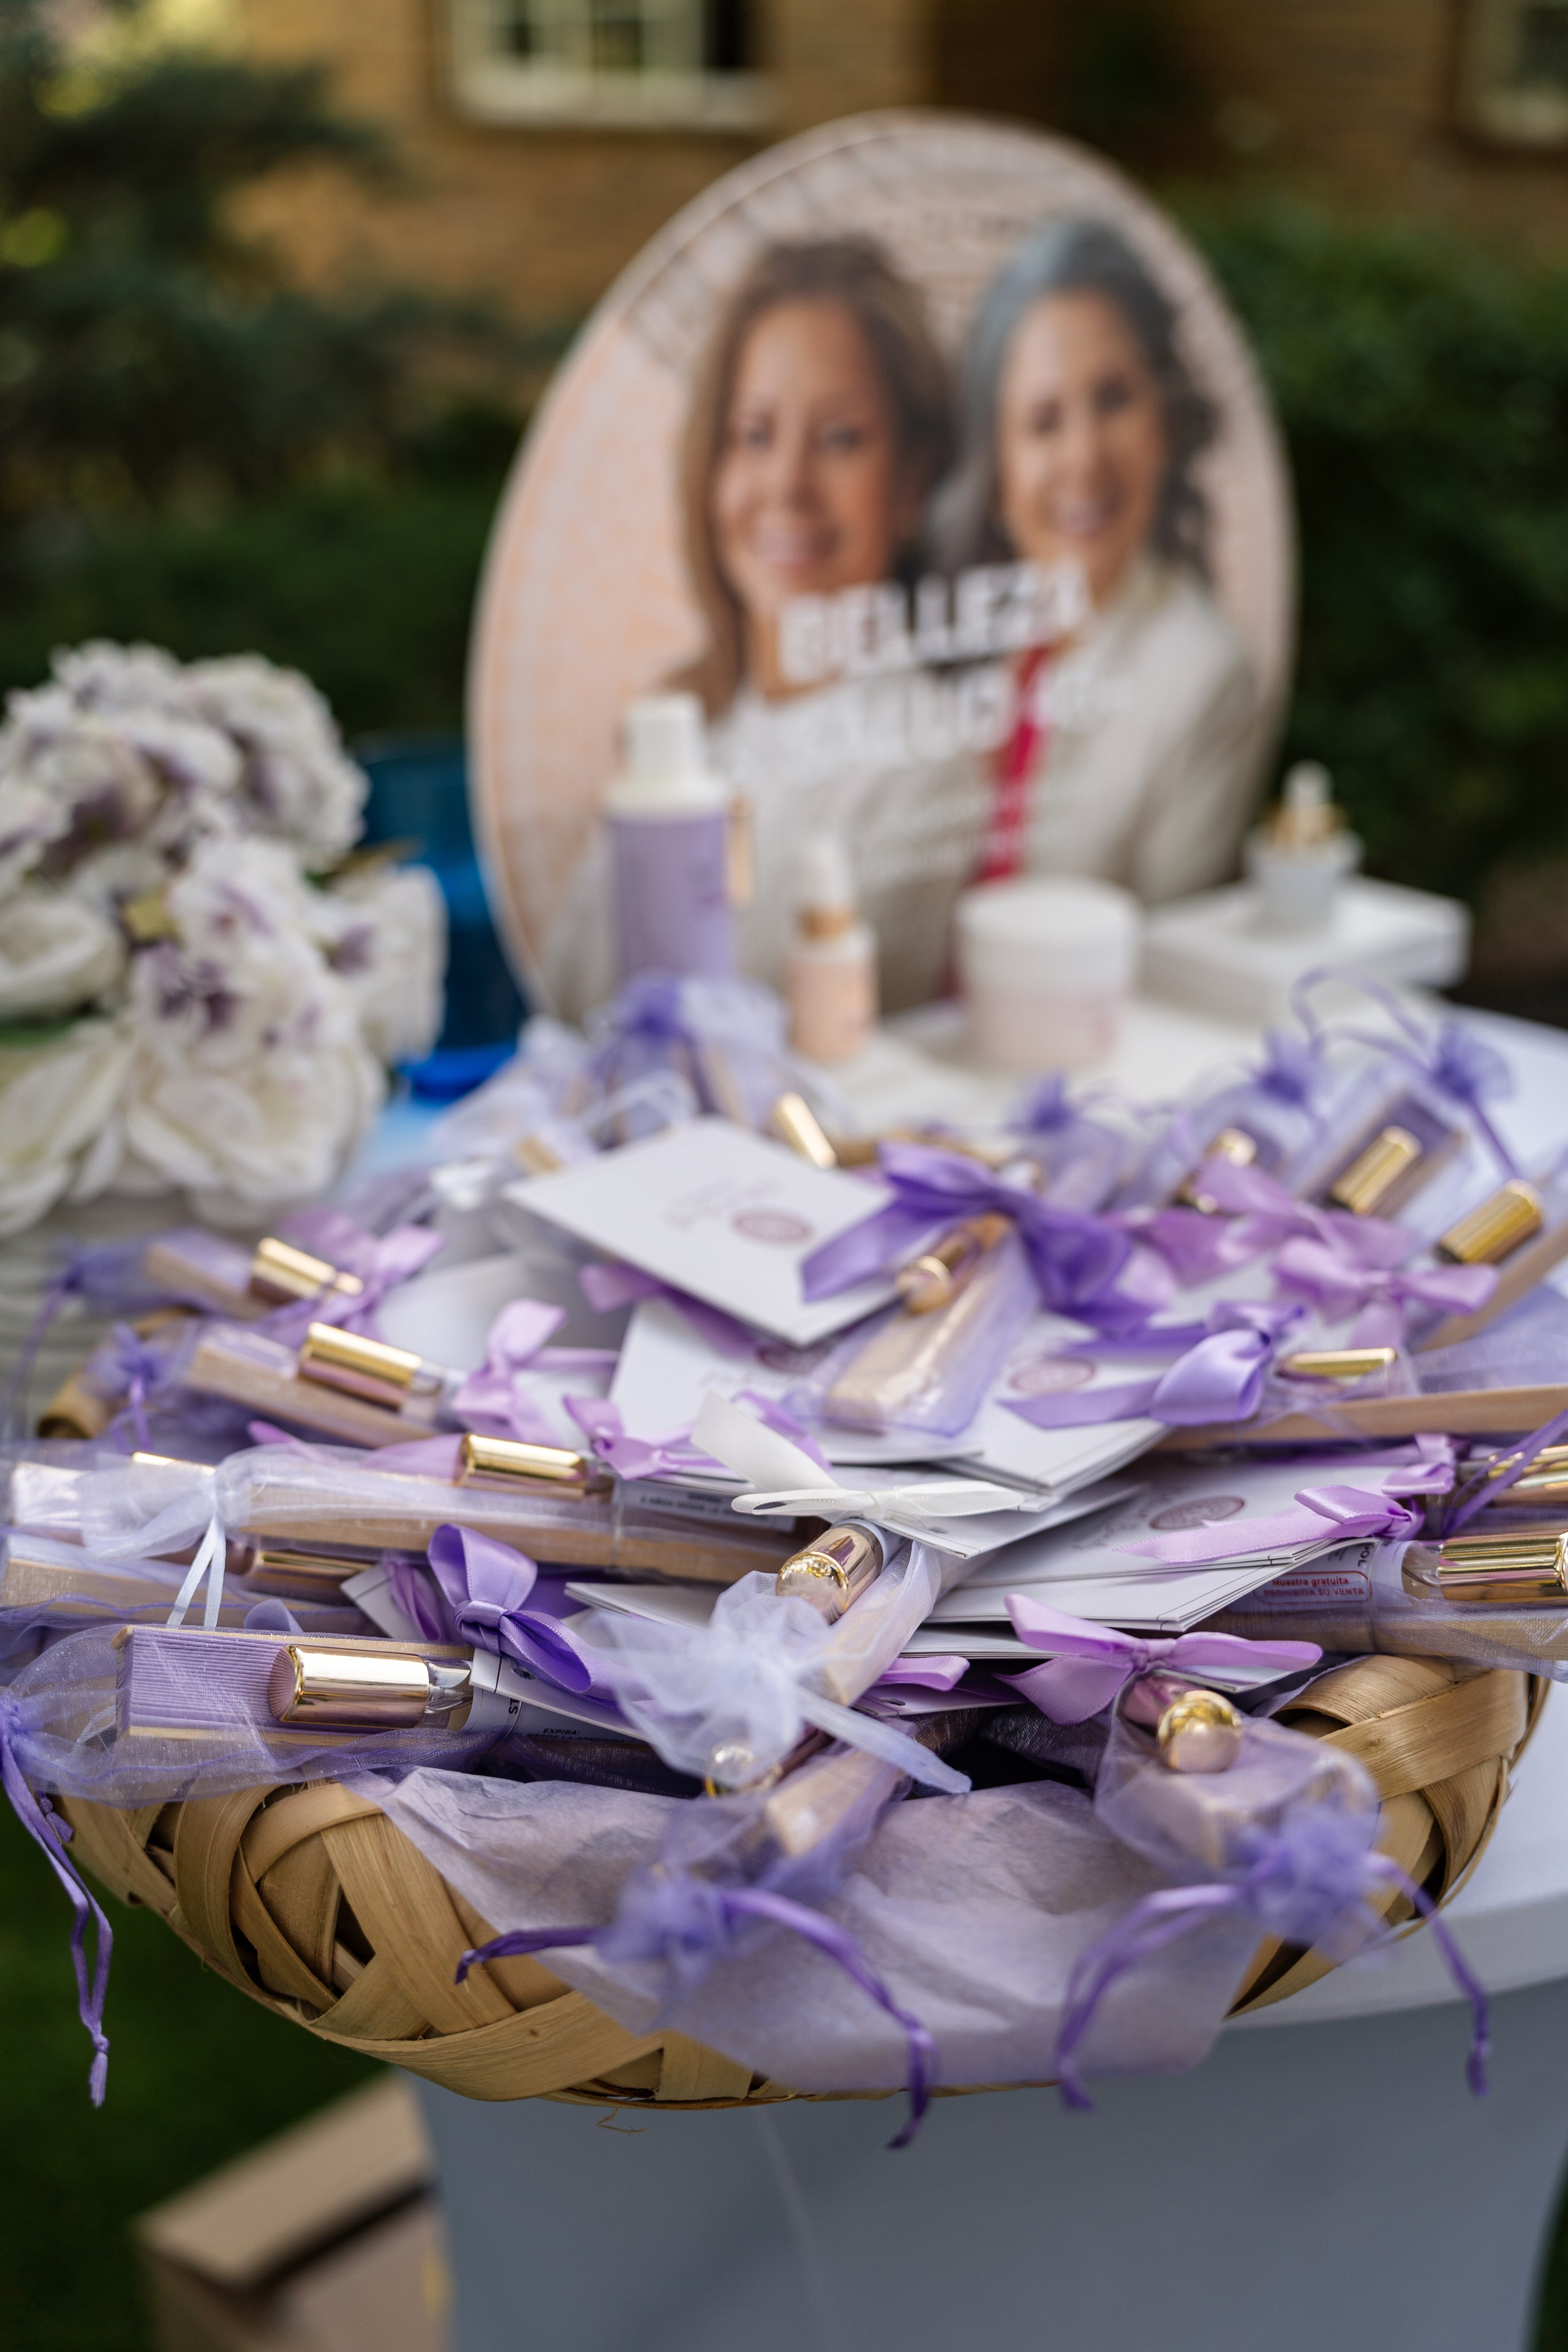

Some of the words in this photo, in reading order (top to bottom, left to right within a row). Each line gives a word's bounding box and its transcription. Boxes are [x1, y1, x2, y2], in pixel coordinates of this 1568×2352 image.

[1272, 1576, 1308, 1586] Muestra
[1311, 1576, 1348, 1588] gratuita
[1333, 1588, 1364, 1596] VENTA
